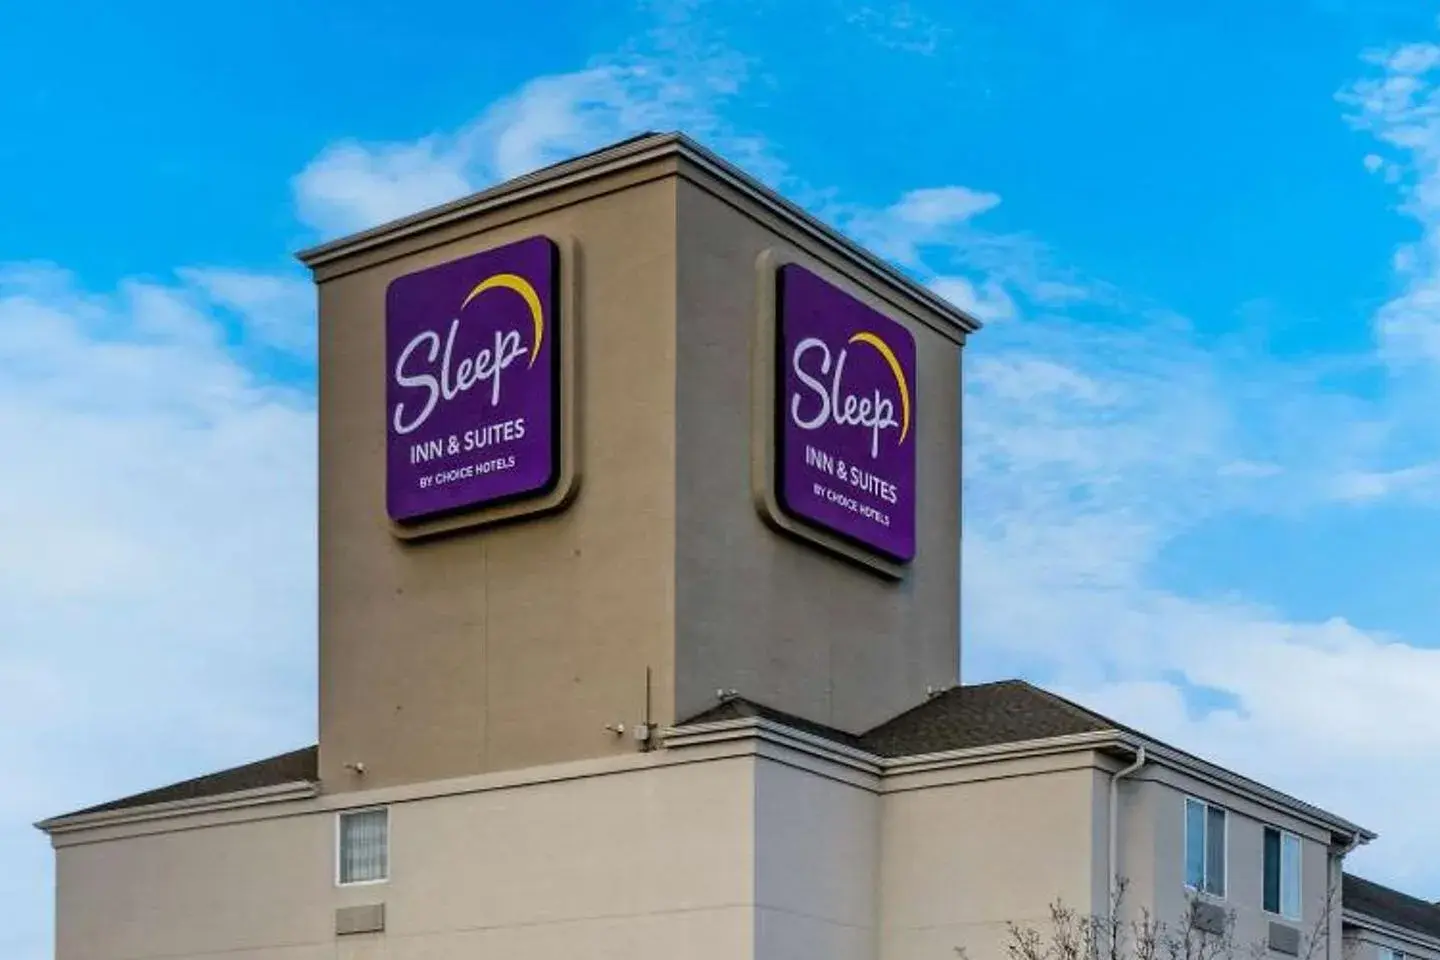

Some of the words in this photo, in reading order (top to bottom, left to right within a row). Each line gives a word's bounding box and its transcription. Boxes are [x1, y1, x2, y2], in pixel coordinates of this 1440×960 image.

[393, 319, 528, 435] Sleep
[791, 337, 899, 460] Sleep
[410, 438, 443, 464] INN
[447, 434, 460, 455] &
[463, 418, 525, 451] SUITES
[420, 475, 433, 488] BY
[435, 465, 474, 485] CHOICE
[475, 455, 516, 475] HOTELS
[806, 445, 834, 475] INN
[837, 460, 848, 481] &
[850, 465, 898, 504] SUITES
[813, 483, 826, 497] BY
[826, 489, 858, 512] CHOICE
[859, 503, 890, 527] HOTELS
